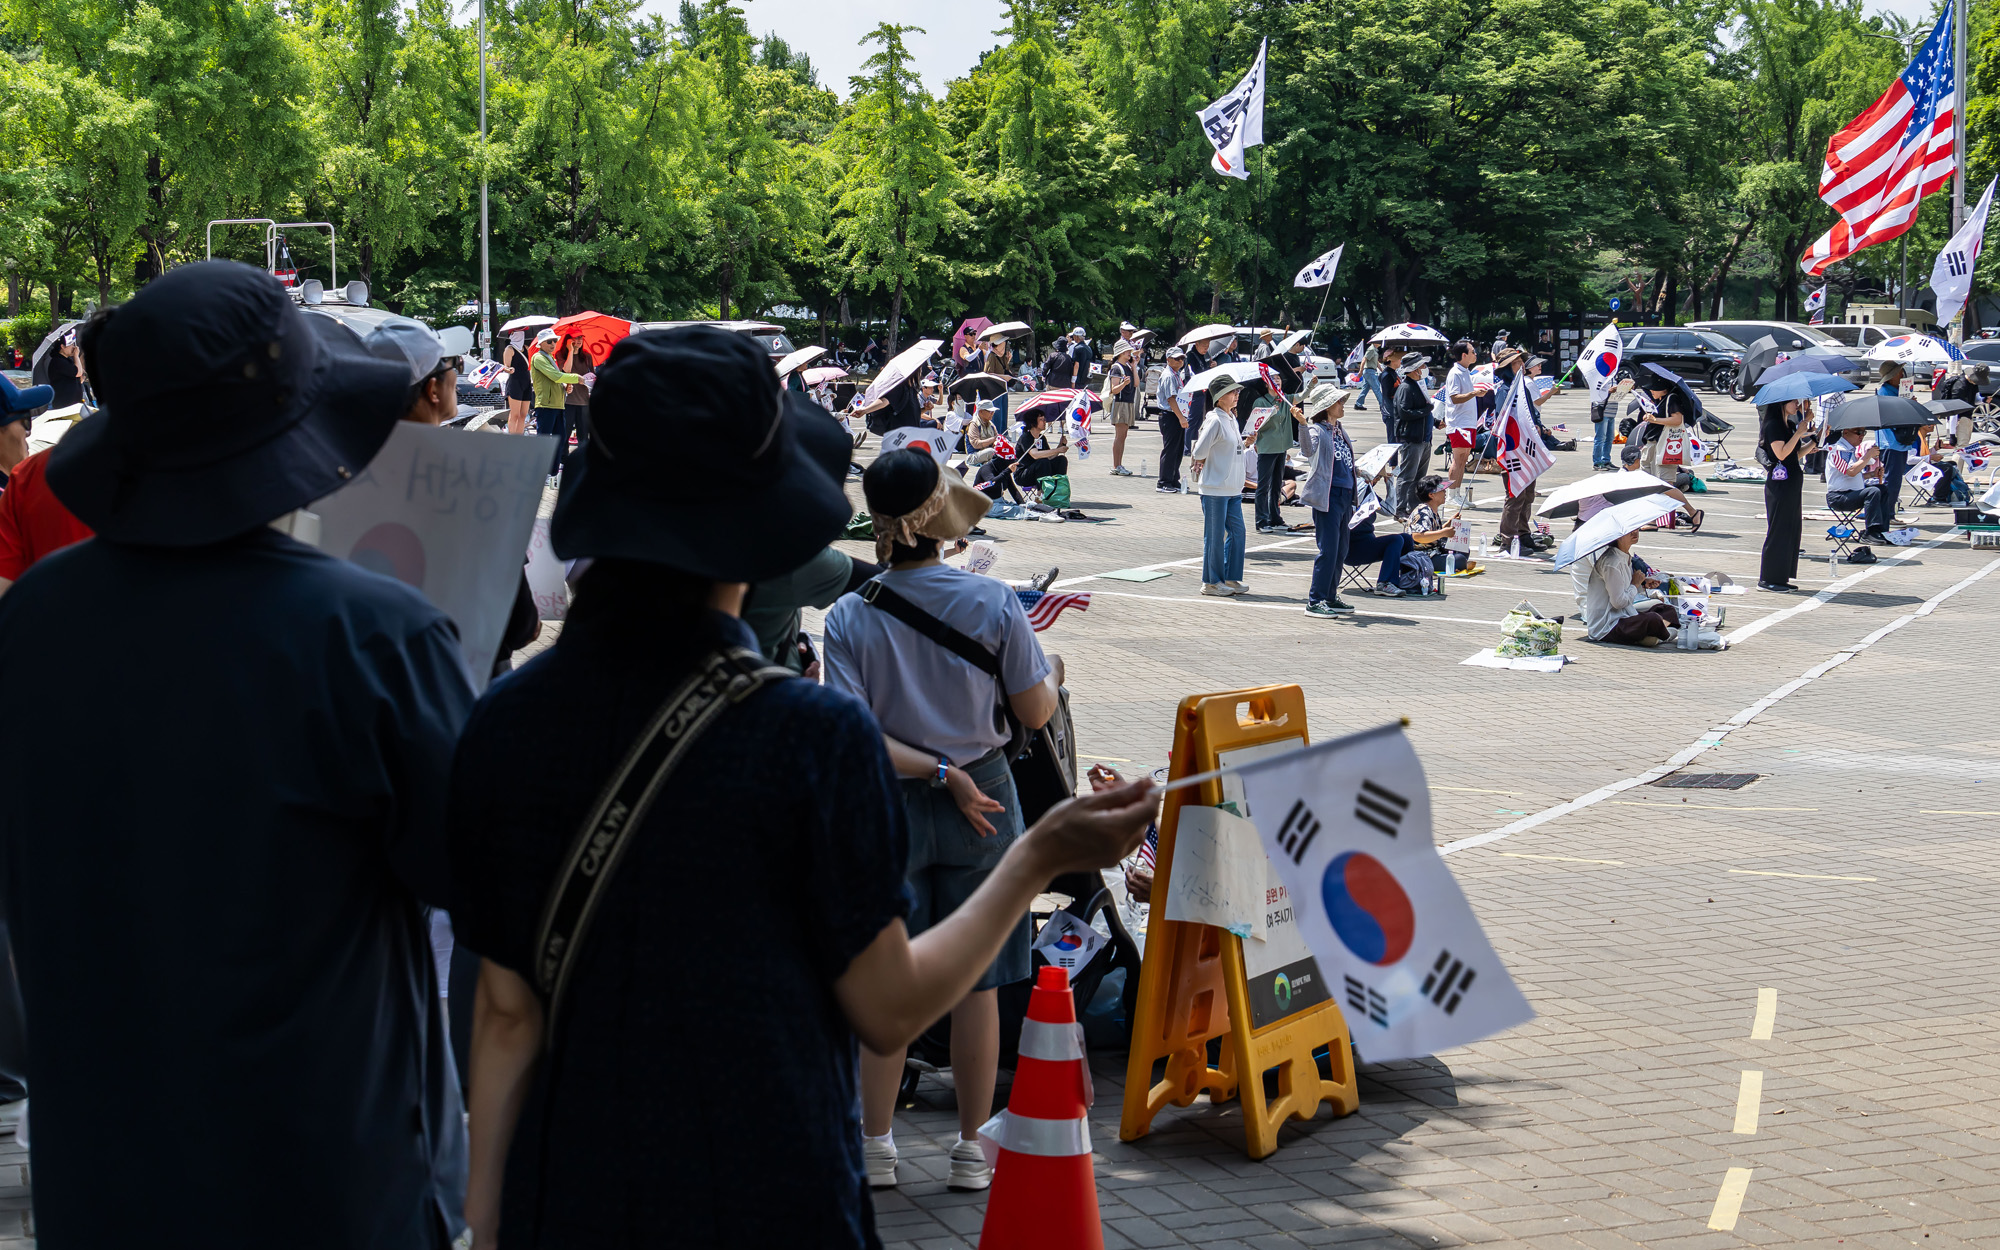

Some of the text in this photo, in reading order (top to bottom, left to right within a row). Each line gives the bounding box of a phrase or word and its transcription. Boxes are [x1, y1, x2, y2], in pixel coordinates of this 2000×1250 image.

[664, 666, 730, 740] CARLYN
[580, 799, 629, 878] CARLYN
[1274, 907, 1293, 926] 주시기
